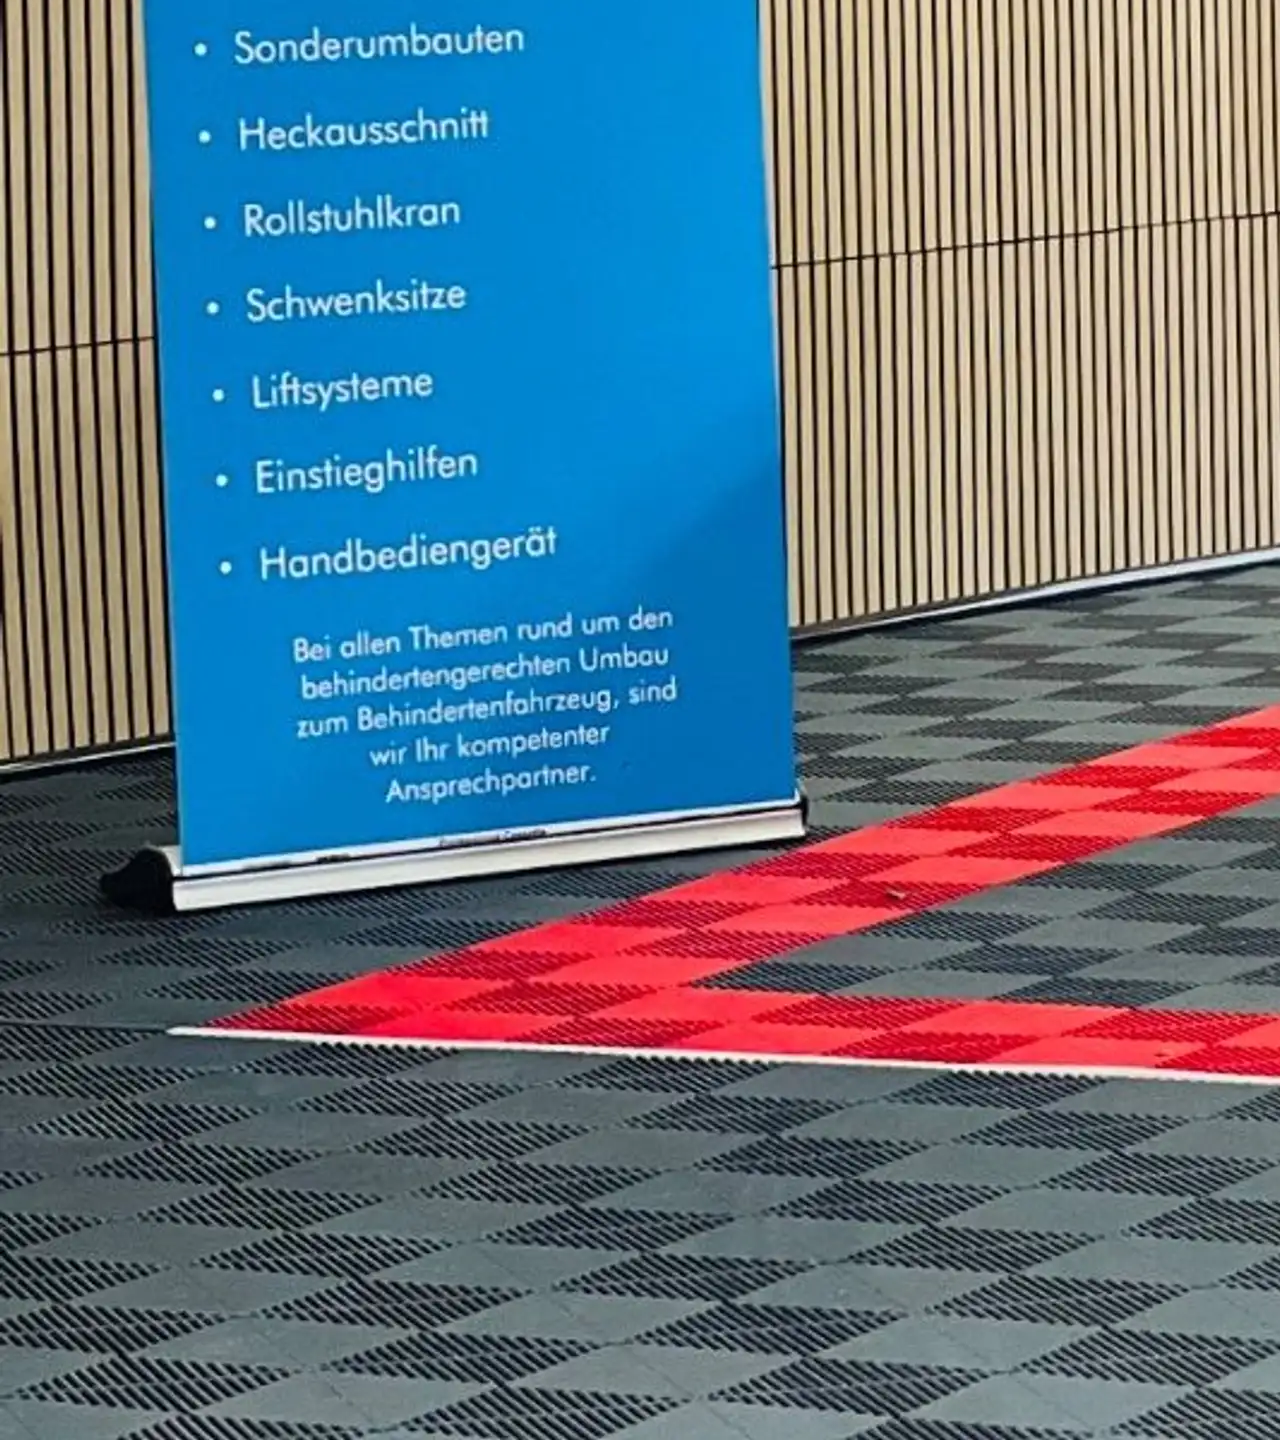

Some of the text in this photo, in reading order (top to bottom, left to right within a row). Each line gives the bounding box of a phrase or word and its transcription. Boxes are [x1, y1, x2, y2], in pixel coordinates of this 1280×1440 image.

[234, 23, 524, 65] Sonderumbauten
[239, 107, 489, 151] Heckausschnitt
[244, 193, 461, 237] Rollstuhlkran
[246, 278, 467, 323] Schwenksitze
[252, 370, 433, 412] Liftsysteme
[256, 444, 478, 494] Einstieghilfen
[260, 526, 557, 580] Handbediengerät
[293, 605, 673, 663] Bei allen Themen rund um den
[301, 642, 669, 700] behindertengerechten Umbau
[296, 675, 678, 739] zum Behindertenfahrzeug, sind
[369, 721, 610, 767] wir Ihr kompetenter
[385, 764, 597, 804] Ansprechpartner.
